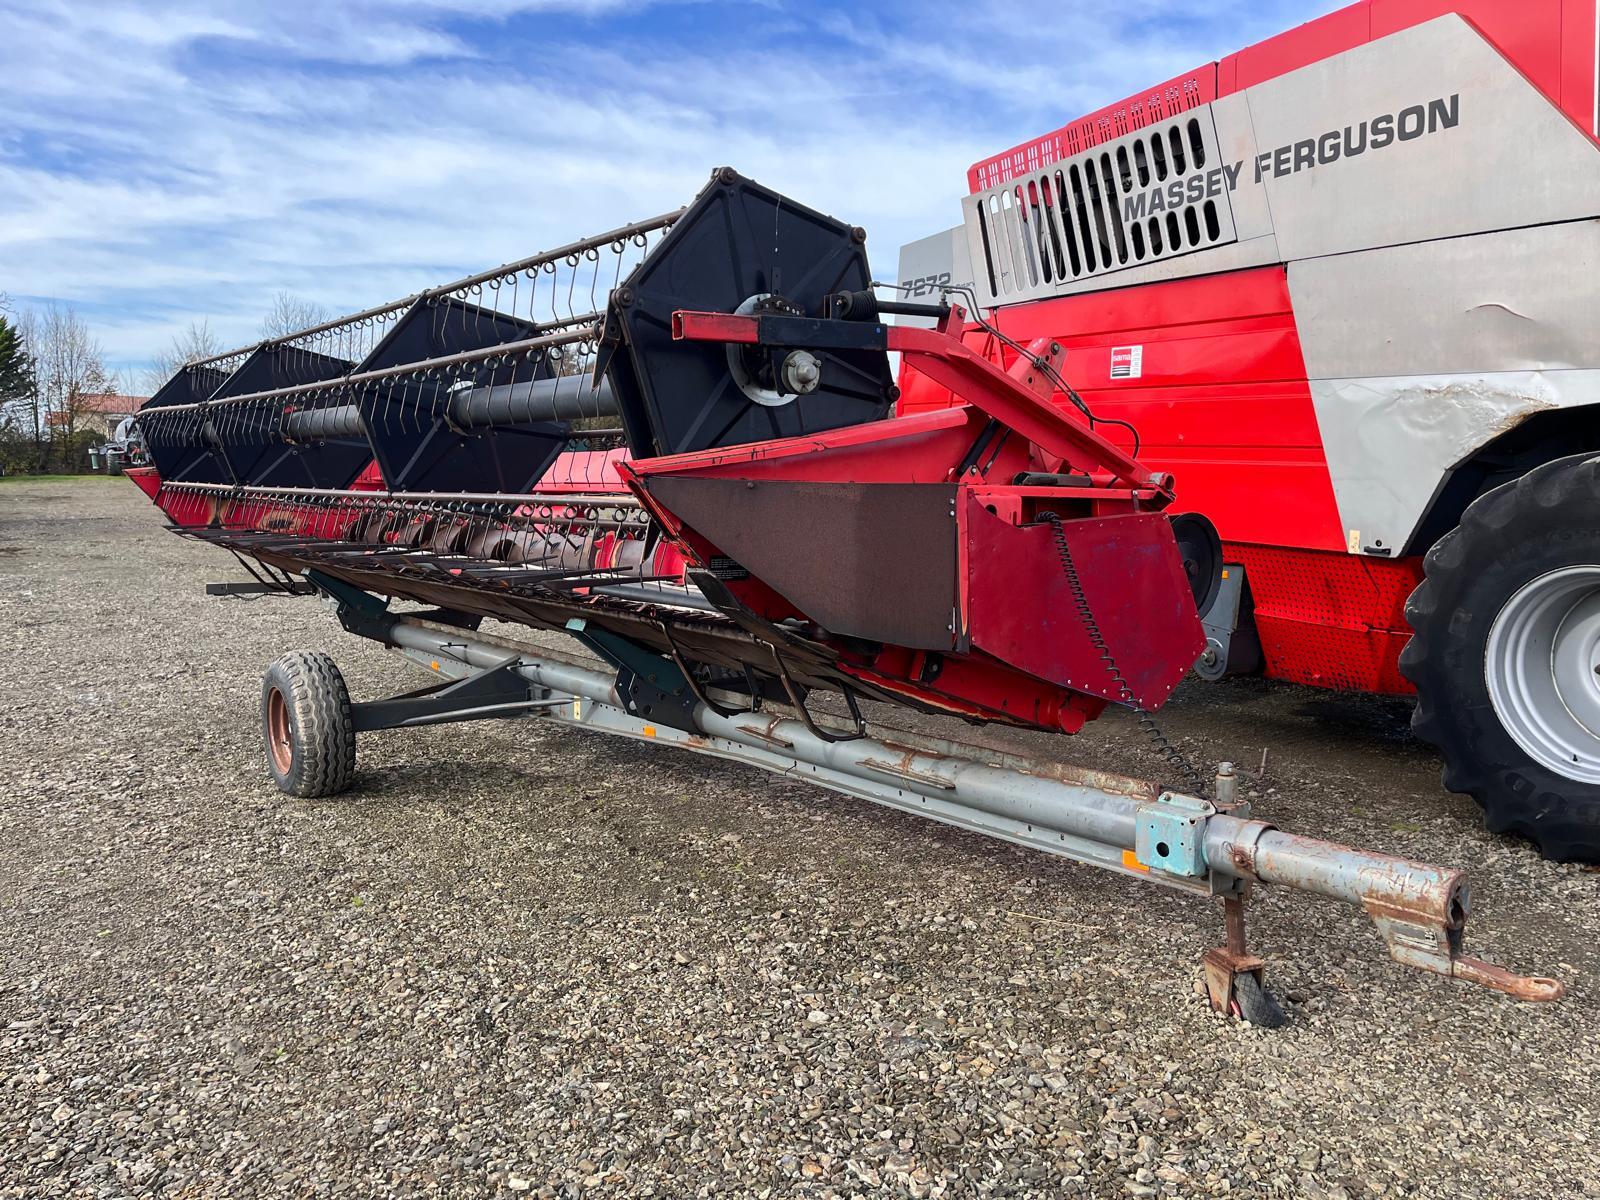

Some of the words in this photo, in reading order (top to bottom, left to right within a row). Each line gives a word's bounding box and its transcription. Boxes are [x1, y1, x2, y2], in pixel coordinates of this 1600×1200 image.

[1124, 160, 1243, 222] MASSEY
[1255, 94, 1459, 184] FERGUSON
[903, 272, 951, 299] 7272
